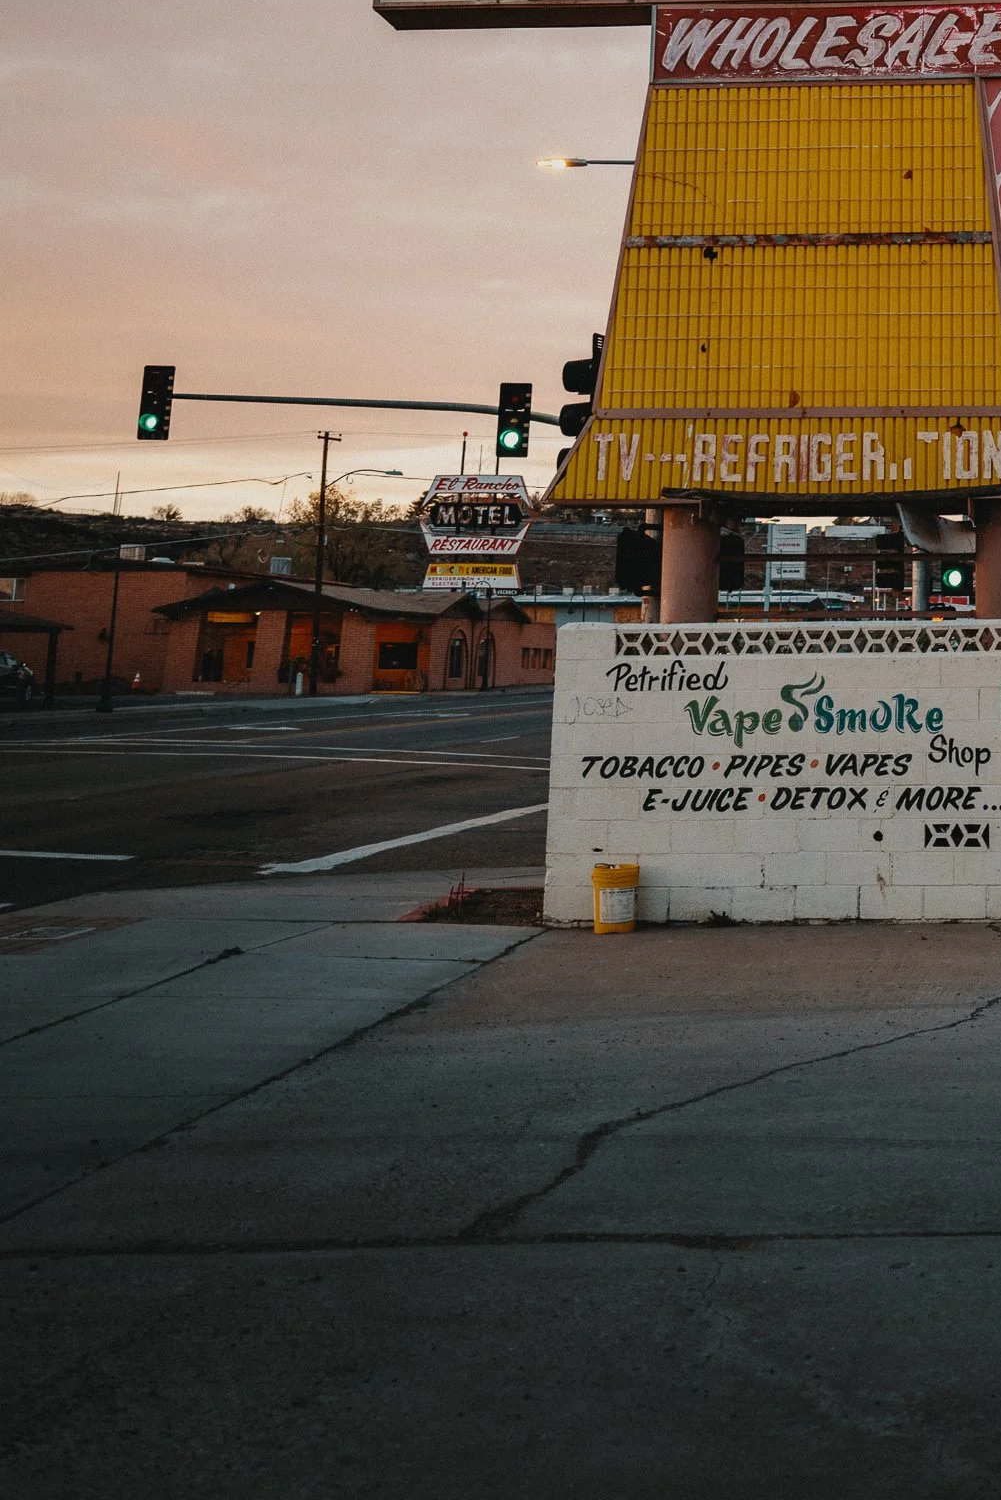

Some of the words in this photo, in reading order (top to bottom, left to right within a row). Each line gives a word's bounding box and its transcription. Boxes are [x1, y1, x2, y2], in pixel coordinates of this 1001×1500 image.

[435, 477, 459, 490] El
[462, 477, 520, 490] Rancho
[436, 506, 516, 525] MOTEL
[429, 537, 518, 551] RESTAURANT
[499, 566, 513, 575] FOOD
[606, 660, 729, 691] Petrified
[683, 695, 783, 749] Vape
[813, 693, 944, 735] Smoke
[581, 755, 705, 779] TOBACCO
[724, 753, 806, 779] PIPES
[825, 753, 912, 777] VAPES
[928, 733, 992, 776] Shop
[642, 787, 753, 812] E-JUICE
[769, 786, 869, 811] DETOX
